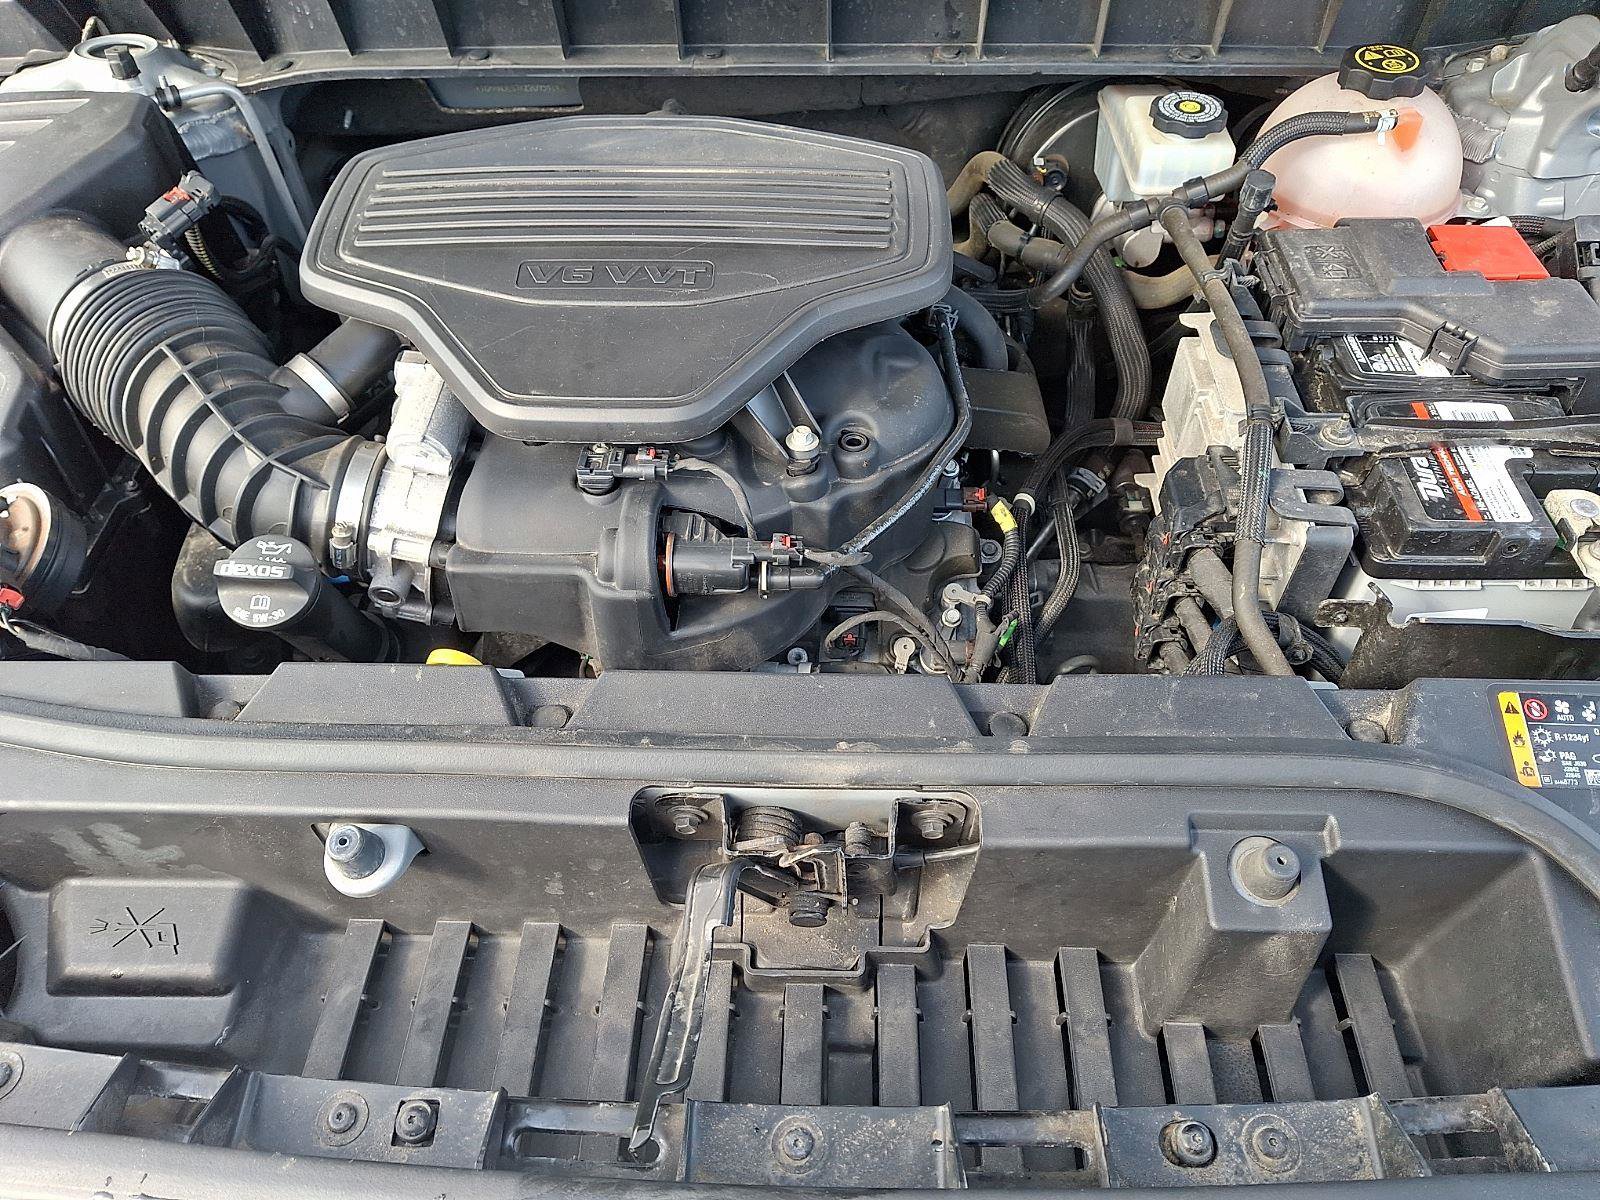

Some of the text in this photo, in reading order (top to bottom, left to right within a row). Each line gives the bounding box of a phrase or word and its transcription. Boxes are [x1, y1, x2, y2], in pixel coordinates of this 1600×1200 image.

[526, 265, 706, 285] V6 VVT
[1410, 456, 1445, 501] Dura
[220, 560, 284, 578] dexos
[233, 606, 250, 620] SAE
[1557, 714, 1575, 722] AUTO
[1554, 732, 1590, 744] R-1234yf
[1559, 751, 1577, 761] PAG
